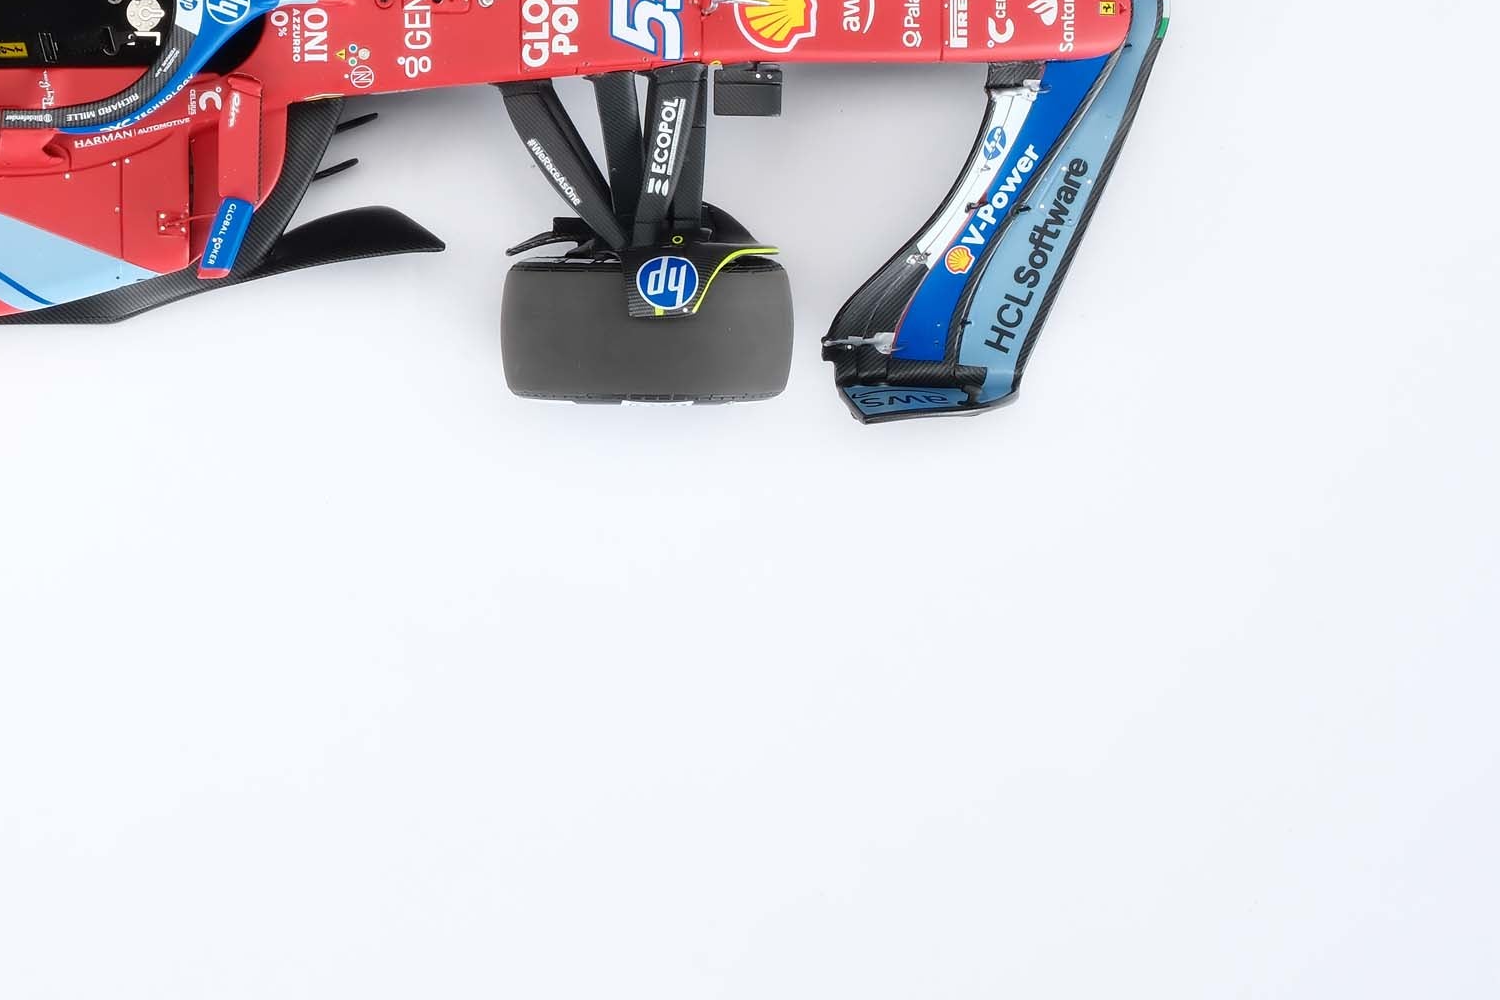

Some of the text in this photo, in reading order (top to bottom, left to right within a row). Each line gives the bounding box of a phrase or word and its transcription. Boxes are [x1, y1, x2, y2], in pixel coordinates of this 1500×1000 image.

[292, 8, 301, 63] AZZURRO
[66, 92, 140, 123] RICHARD MILLE
[134, 72, 194, 121] TECHNOLOGY
[74, 117, 191, 149] HARMAN AUTOMOTIVE
[651, 98, 679, 175] ECOPOL
[527, 137, 581, 206] #WeRaceAsOne
[960, 143, 1041, 246] V-Power
[206, 203, 237, 265] GLOBAL POKER
[984, 157, 1089, 354] HCLSoftware
[647, 256, 688, 309] hp
